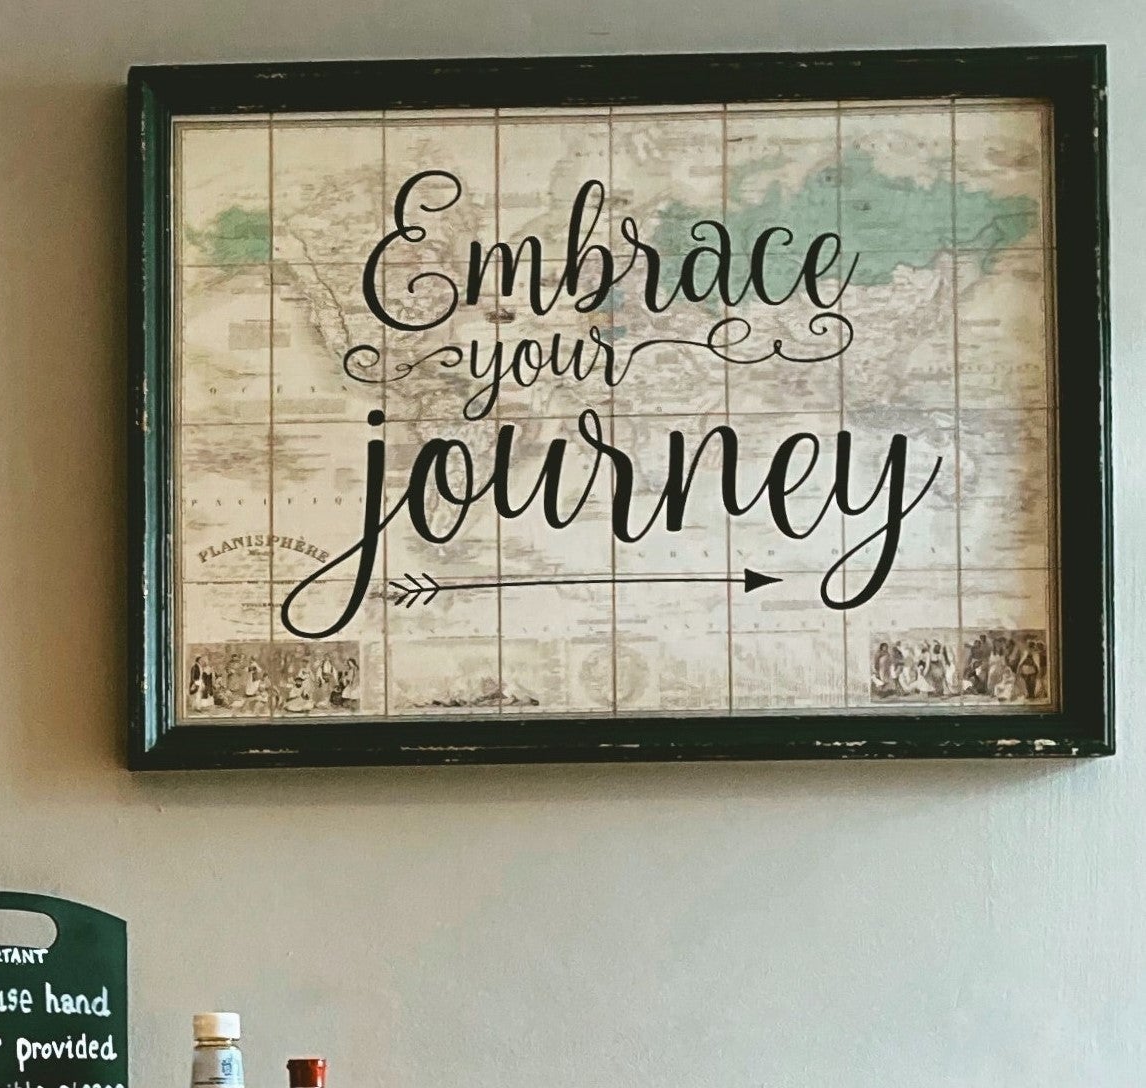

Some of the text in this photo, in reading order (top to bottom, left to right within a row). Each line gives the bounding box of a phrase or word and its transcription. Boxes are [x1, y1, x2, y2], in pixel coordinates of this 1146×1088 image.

[362, 170, 860, 332] Embrace
[463, 325, 634, 421] your
[281, 408, 943, 640] journey
[45, 982, 112, 1017] hand
[16, 1034, 118, 1072] provided
